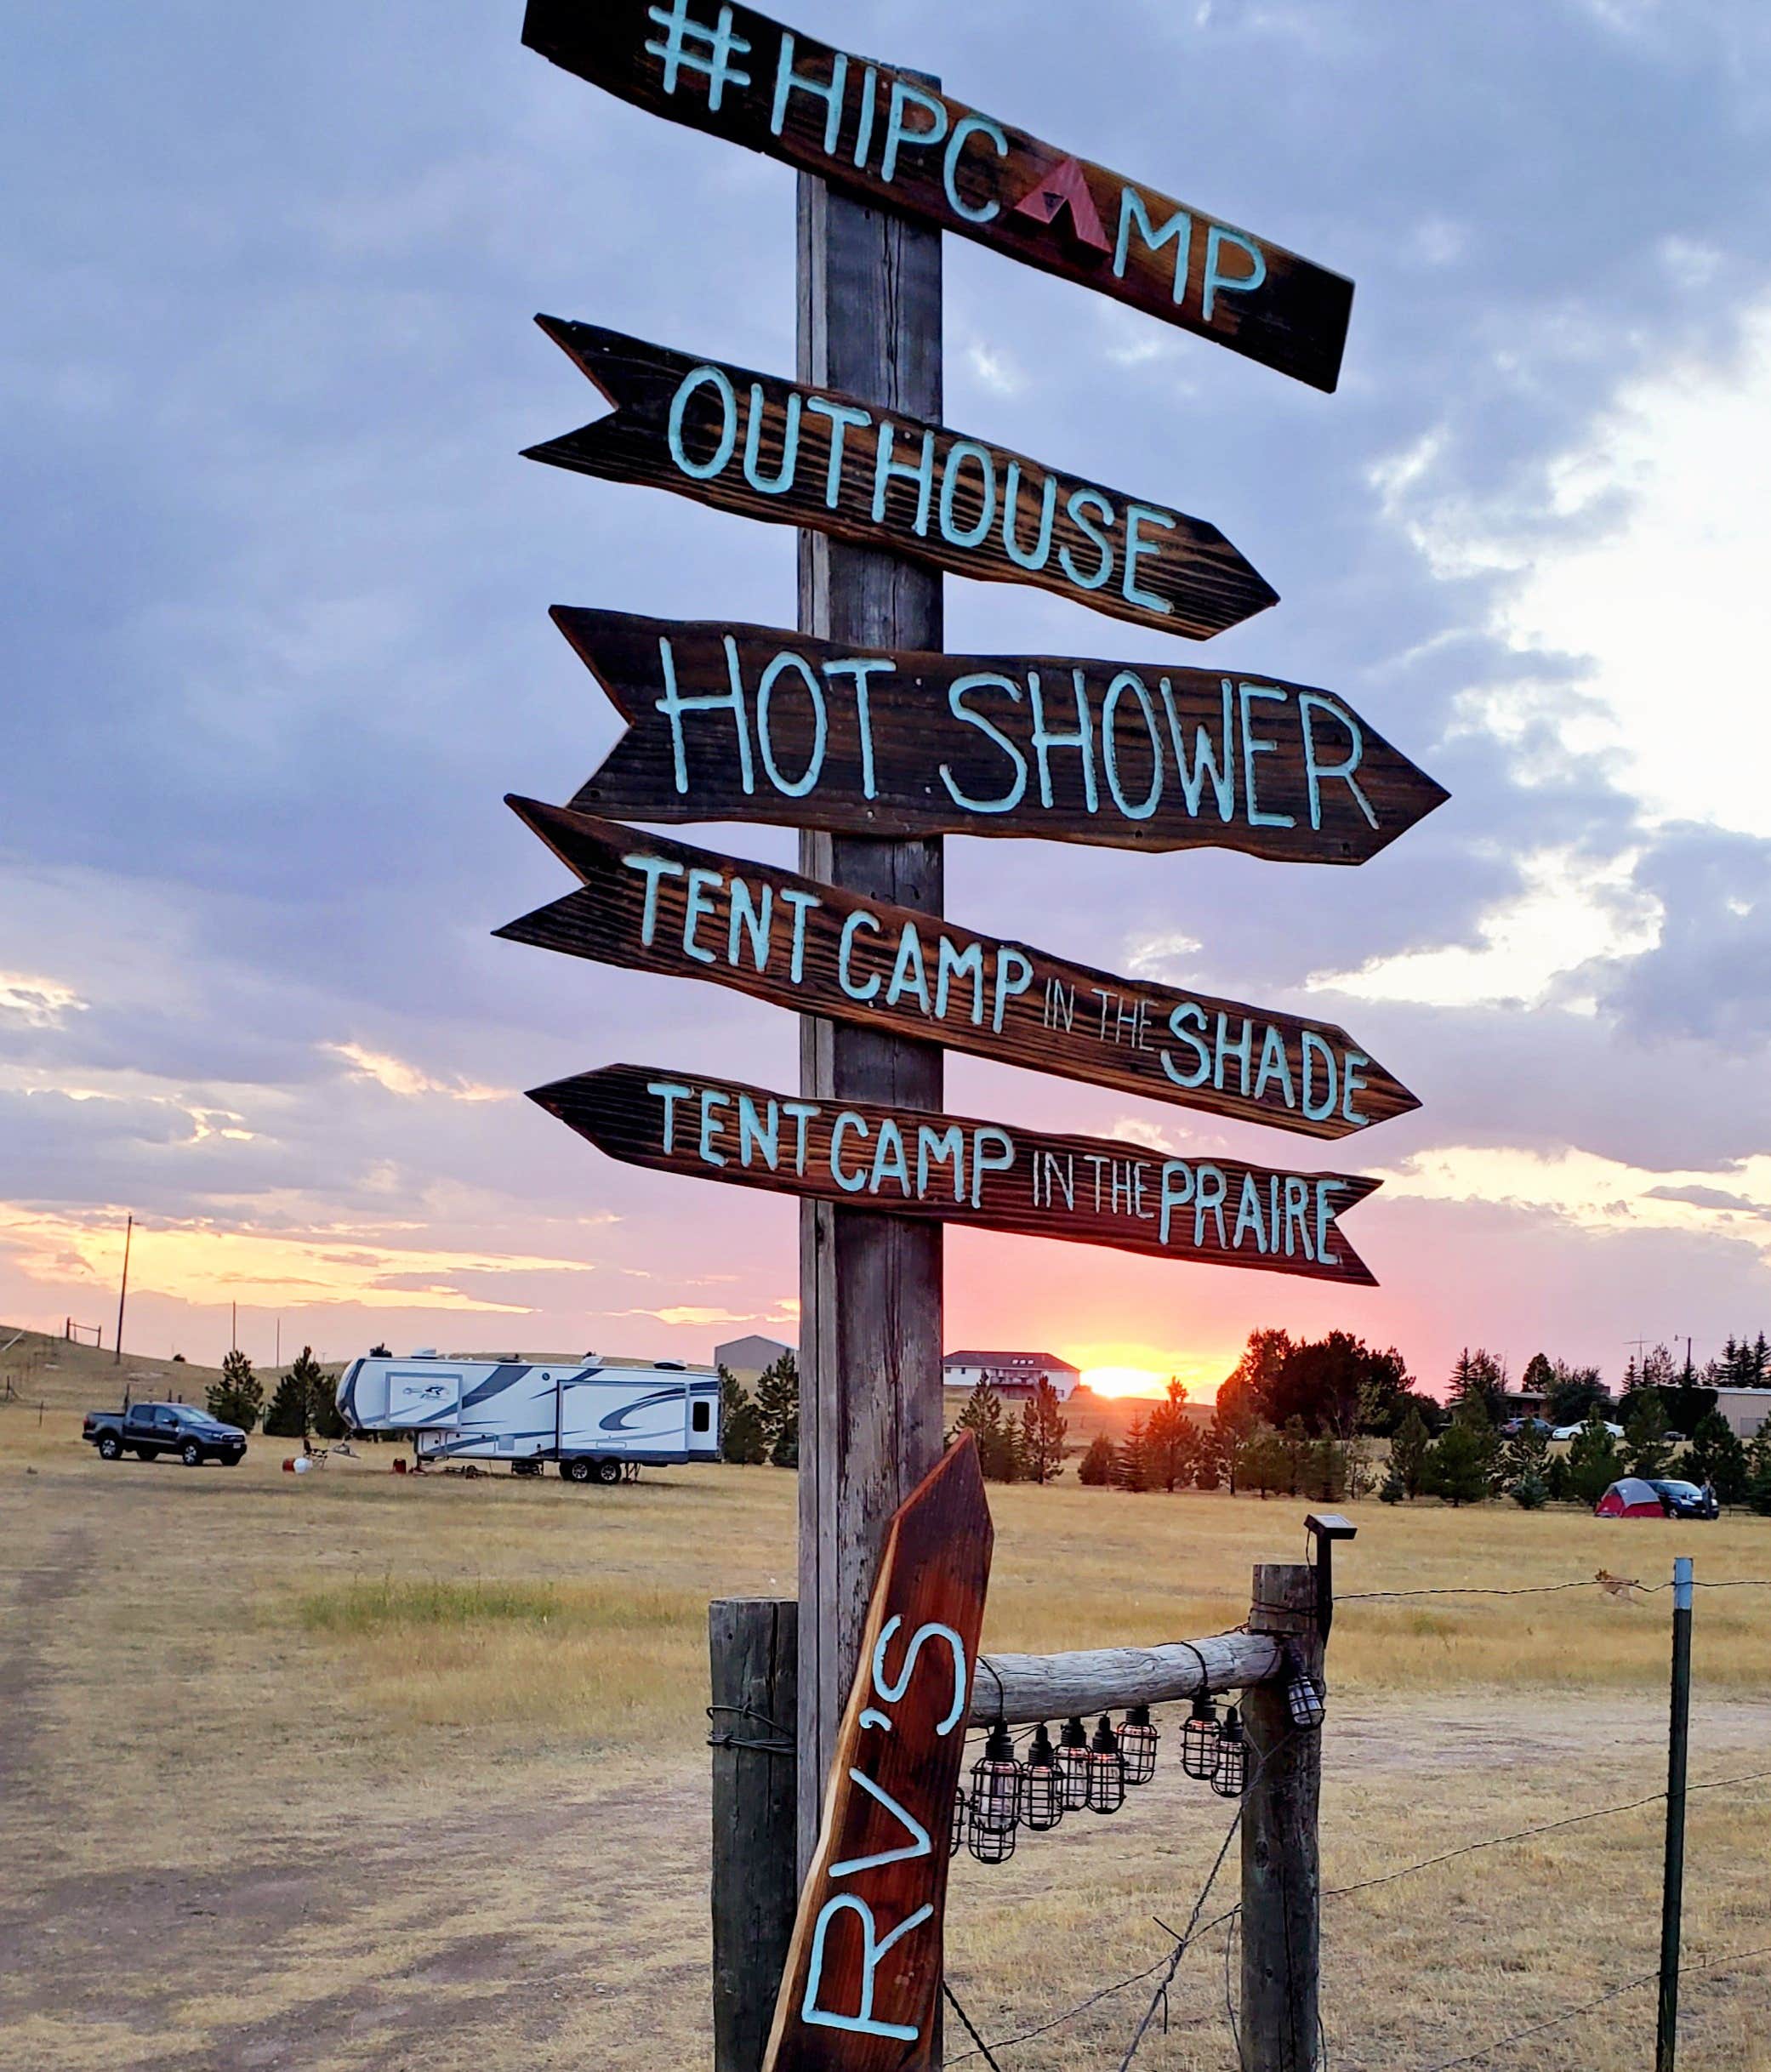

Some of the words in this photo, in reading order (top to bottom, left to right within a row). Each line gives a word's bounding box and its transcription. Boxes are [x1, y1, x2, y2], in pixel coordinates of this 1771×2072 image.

[668, 365, 1175, 614] OUTHOUSE
[655, 635, 897, 801] HOT
[938, 667, 1381, 832] SHOWER
[623, 854, 822, 984] TENT
[839, 909, 1034, 1034] CAMP
[1044, 977, 1075, 1033] IN
[1091, 988, 1159, 1052] THE
[1160, 1002, 1370, 1126] SHADE
[647, 1082, 821, 1177] TENT
[830, 1111, 1016, 1210] CAMP
[1034, 1150, 1074, 1212] IN
[1084, 1153, 1154, 1219] THE
[1159, 1160, 1347, 1267] PRAIRE
[801, 1614, 966, 2041] RV'S
